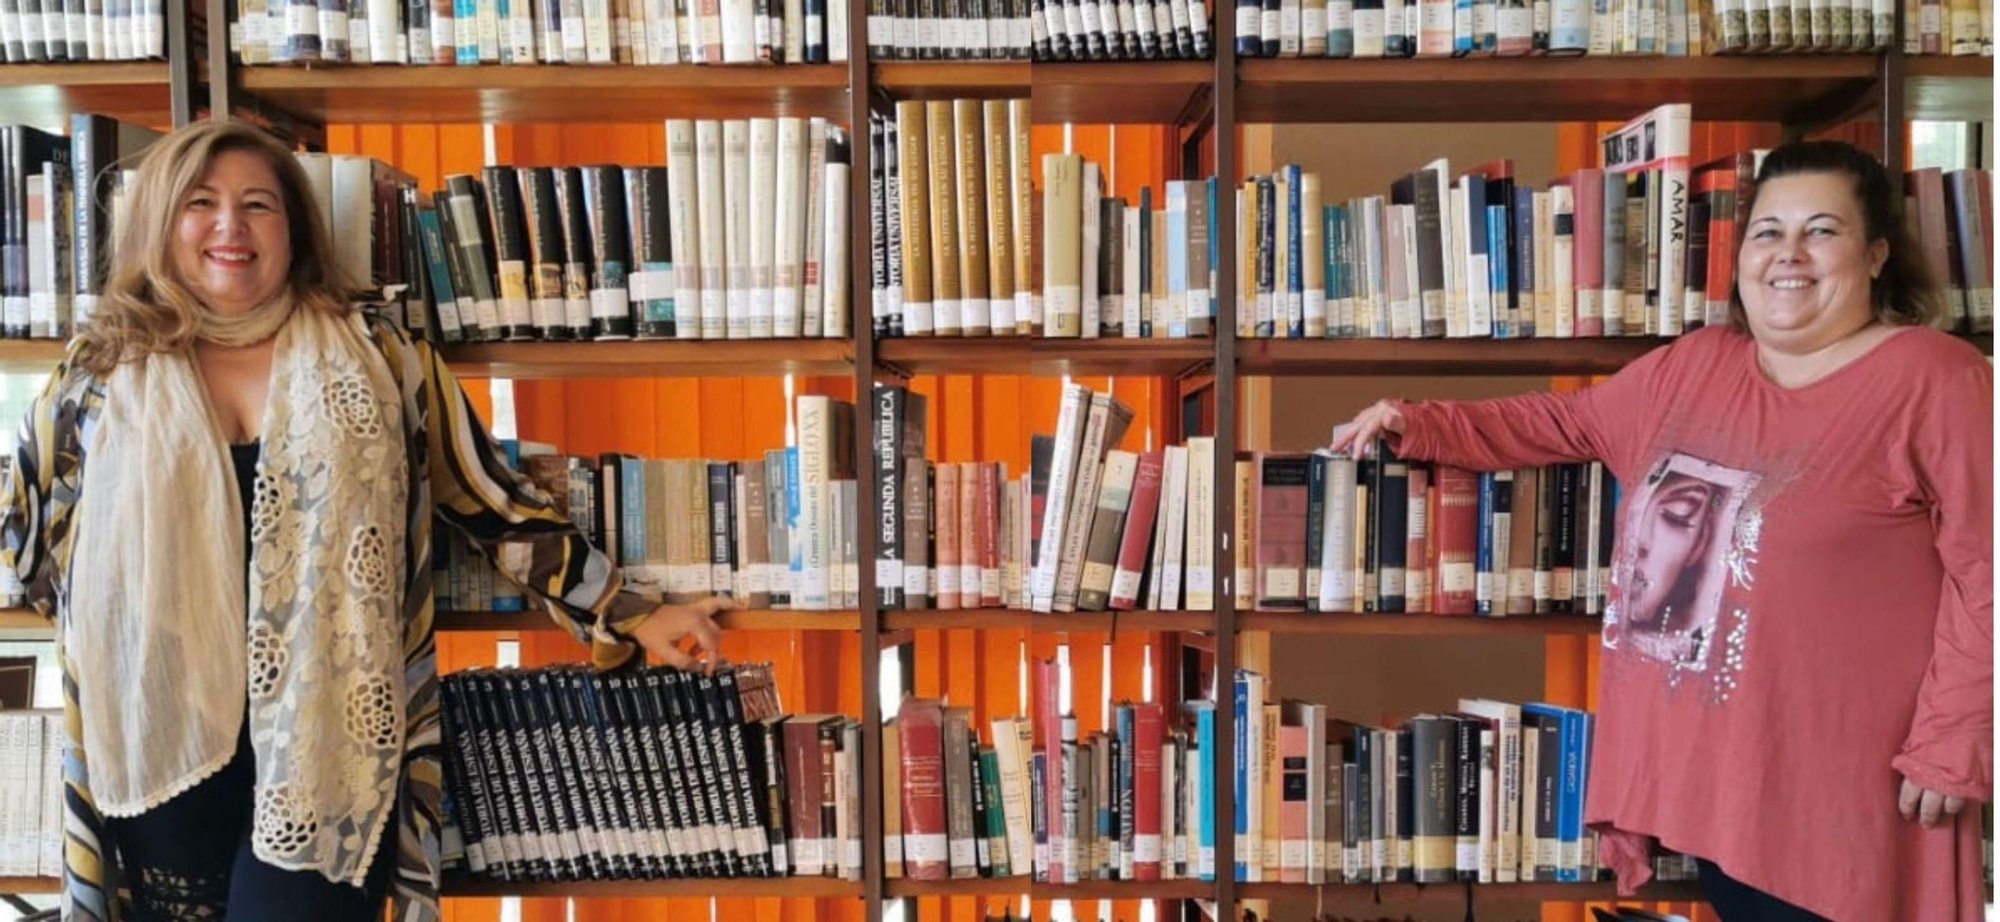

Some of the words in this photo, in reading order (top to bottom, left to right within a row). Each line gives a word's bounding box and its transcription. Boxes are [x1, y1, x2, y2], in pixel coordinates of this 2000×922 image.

[1670, 180, 1685, 243] AMAR
[872, 248, 884, 289] STORIA
[890, 244, 903, 286] STORIA
[881, 391, 894, 469] REPUBLICA
[882, 475, 894, 543] SEGUNDA
[458, 731, 478, 776] ESPAÑA
[479, 729, 498, 774] ESPAÑA
[496, 729, 516, 774] ESPAÑA
[515, 728, 535, 774] ESPAÑA
[533, 728, 553, 773] ESPAÑA
[551, 722, 570, 768] ESPAÑA
[570, 726, 590, 770] ESPAÑA
[605, 728, 625, 772] ESPAÑA
[623, 726, 642, 771] ESPAÑA
[640, 726, 659, 770] ESPAÑA
[659, 724, 678, 768] ESPAÑA
[675, 722, 694, 767] ESPAÑA
[691, 720, 710, 765] ESPAÑA
[711, 727, 730, 772] ESPAÑA
[729, 725, 747, 769] ESPAÑA
[470, 778, 483, 795] DE
[489, 776, 503, 794] DE
[507, 776, 521, 794] DE
[527, 775, 540, 793] DE
[544, 775, 558, 792] DE
[562, 768, 576, 787] DE
[582, 771, 595, 790] DE
[596, 772, 610, 790] DE
[617, 772, 630, 790] DE
[635, 772, 647, 790] DE
[651, 772, 664, 789] DE
[670, 770, 682, 788] DE
[686, 768, 699, 786] DE
[702, 766, 716, 784] DE
[721, 773, 733, 791] DE
[738, 770, 750, 788] DE
[474, 797, 492, 837] STORIA
[495, 795, 513, 834] STORIA
[512, 795, 530, 831] TORIA
[531, 794, 550, 834] STORIA
[551, 793, 567, 830] TORIA
[569, 788, 586, 825] TORIA
[588, 790, 605, 827] TORIA
[603, 791, 620, 827] TORIA
[623, 792, 639, 828] TORIA
[640, 791, 656, 828] TORIA
[658, 791, 673, 828] TORIA
[675, 789, 690, 825] TORIA
[691, 787, 707, 823] TORIA
[707, 785, 725, 826] STORIA
[726, 792, 741, 827] TORIA
[743, 790, 757, 826] TORIA
